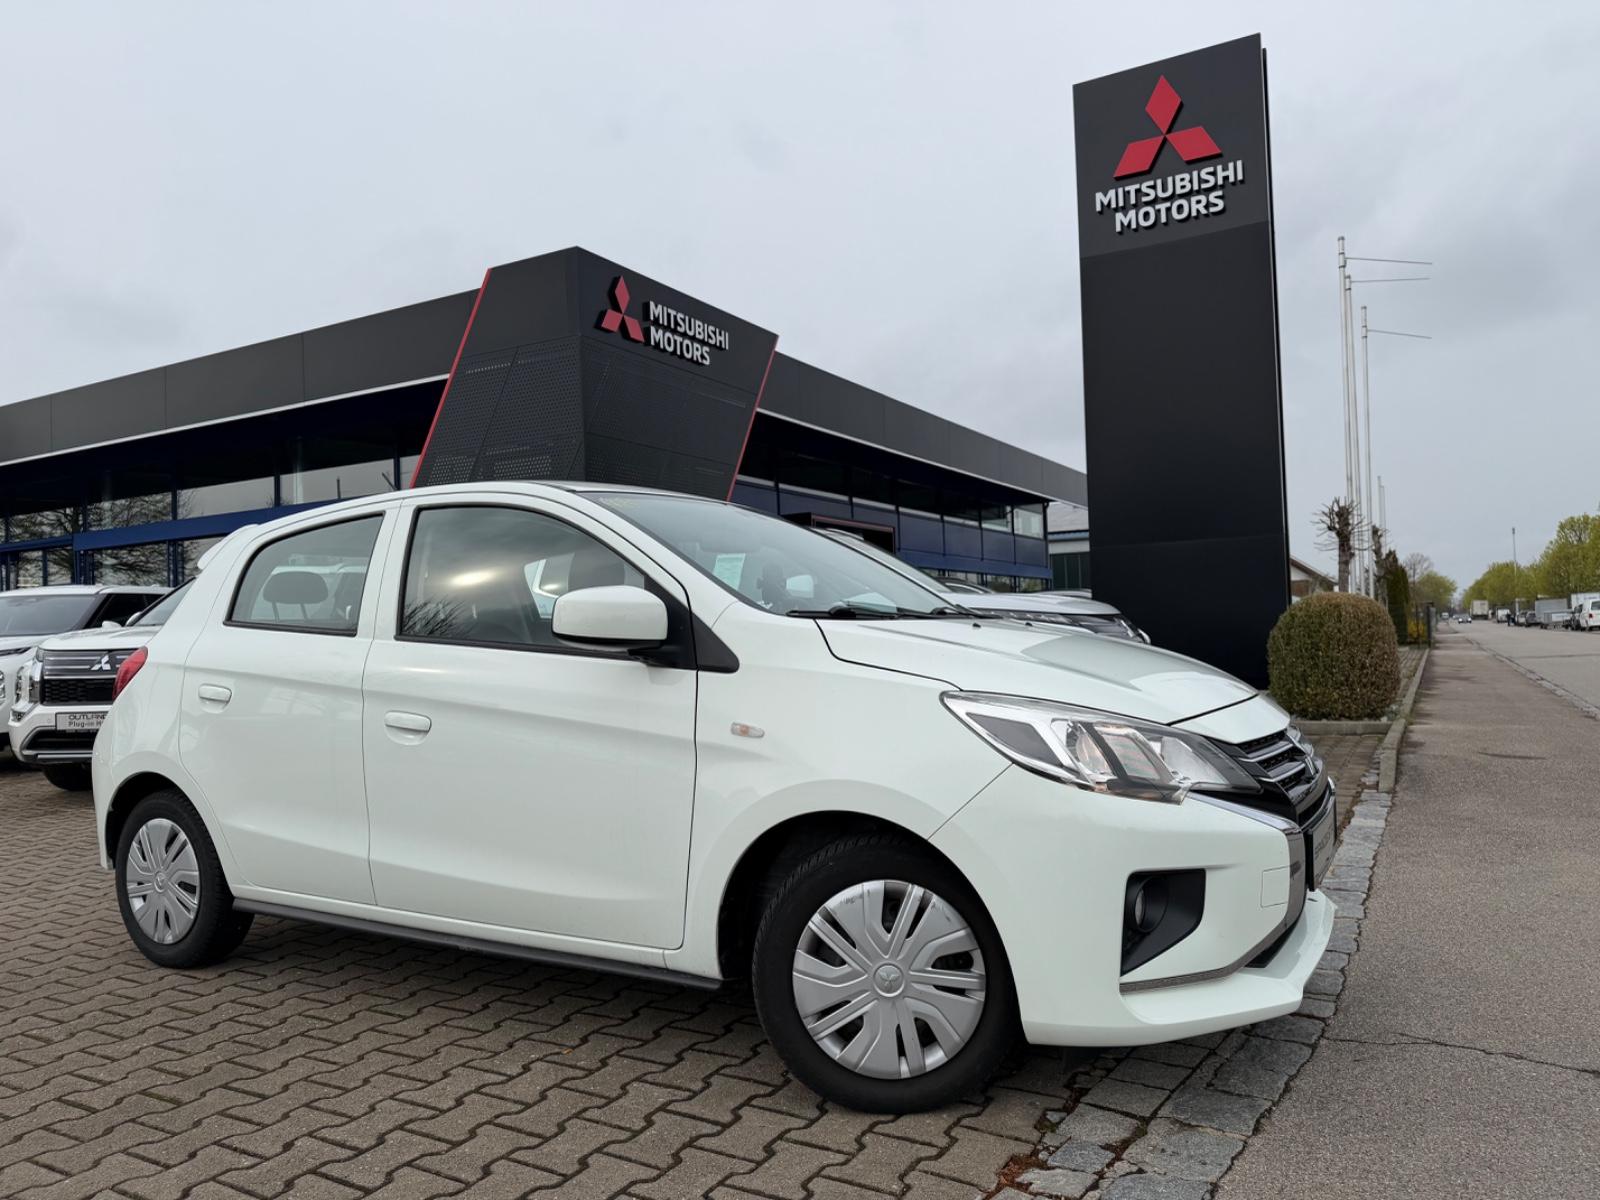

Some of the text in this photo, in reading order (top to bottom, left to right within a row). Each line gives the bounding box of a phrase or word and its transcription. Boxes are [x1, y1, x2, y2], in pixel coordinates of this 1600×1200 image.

[1095, 160, 1244, 212] MITSUBISHI
[1115, 191, 1225, 233] MOTORS
[649, 300, 729, 350] MITSUBISHI
[650, 326, 710, 366] MOTORS
